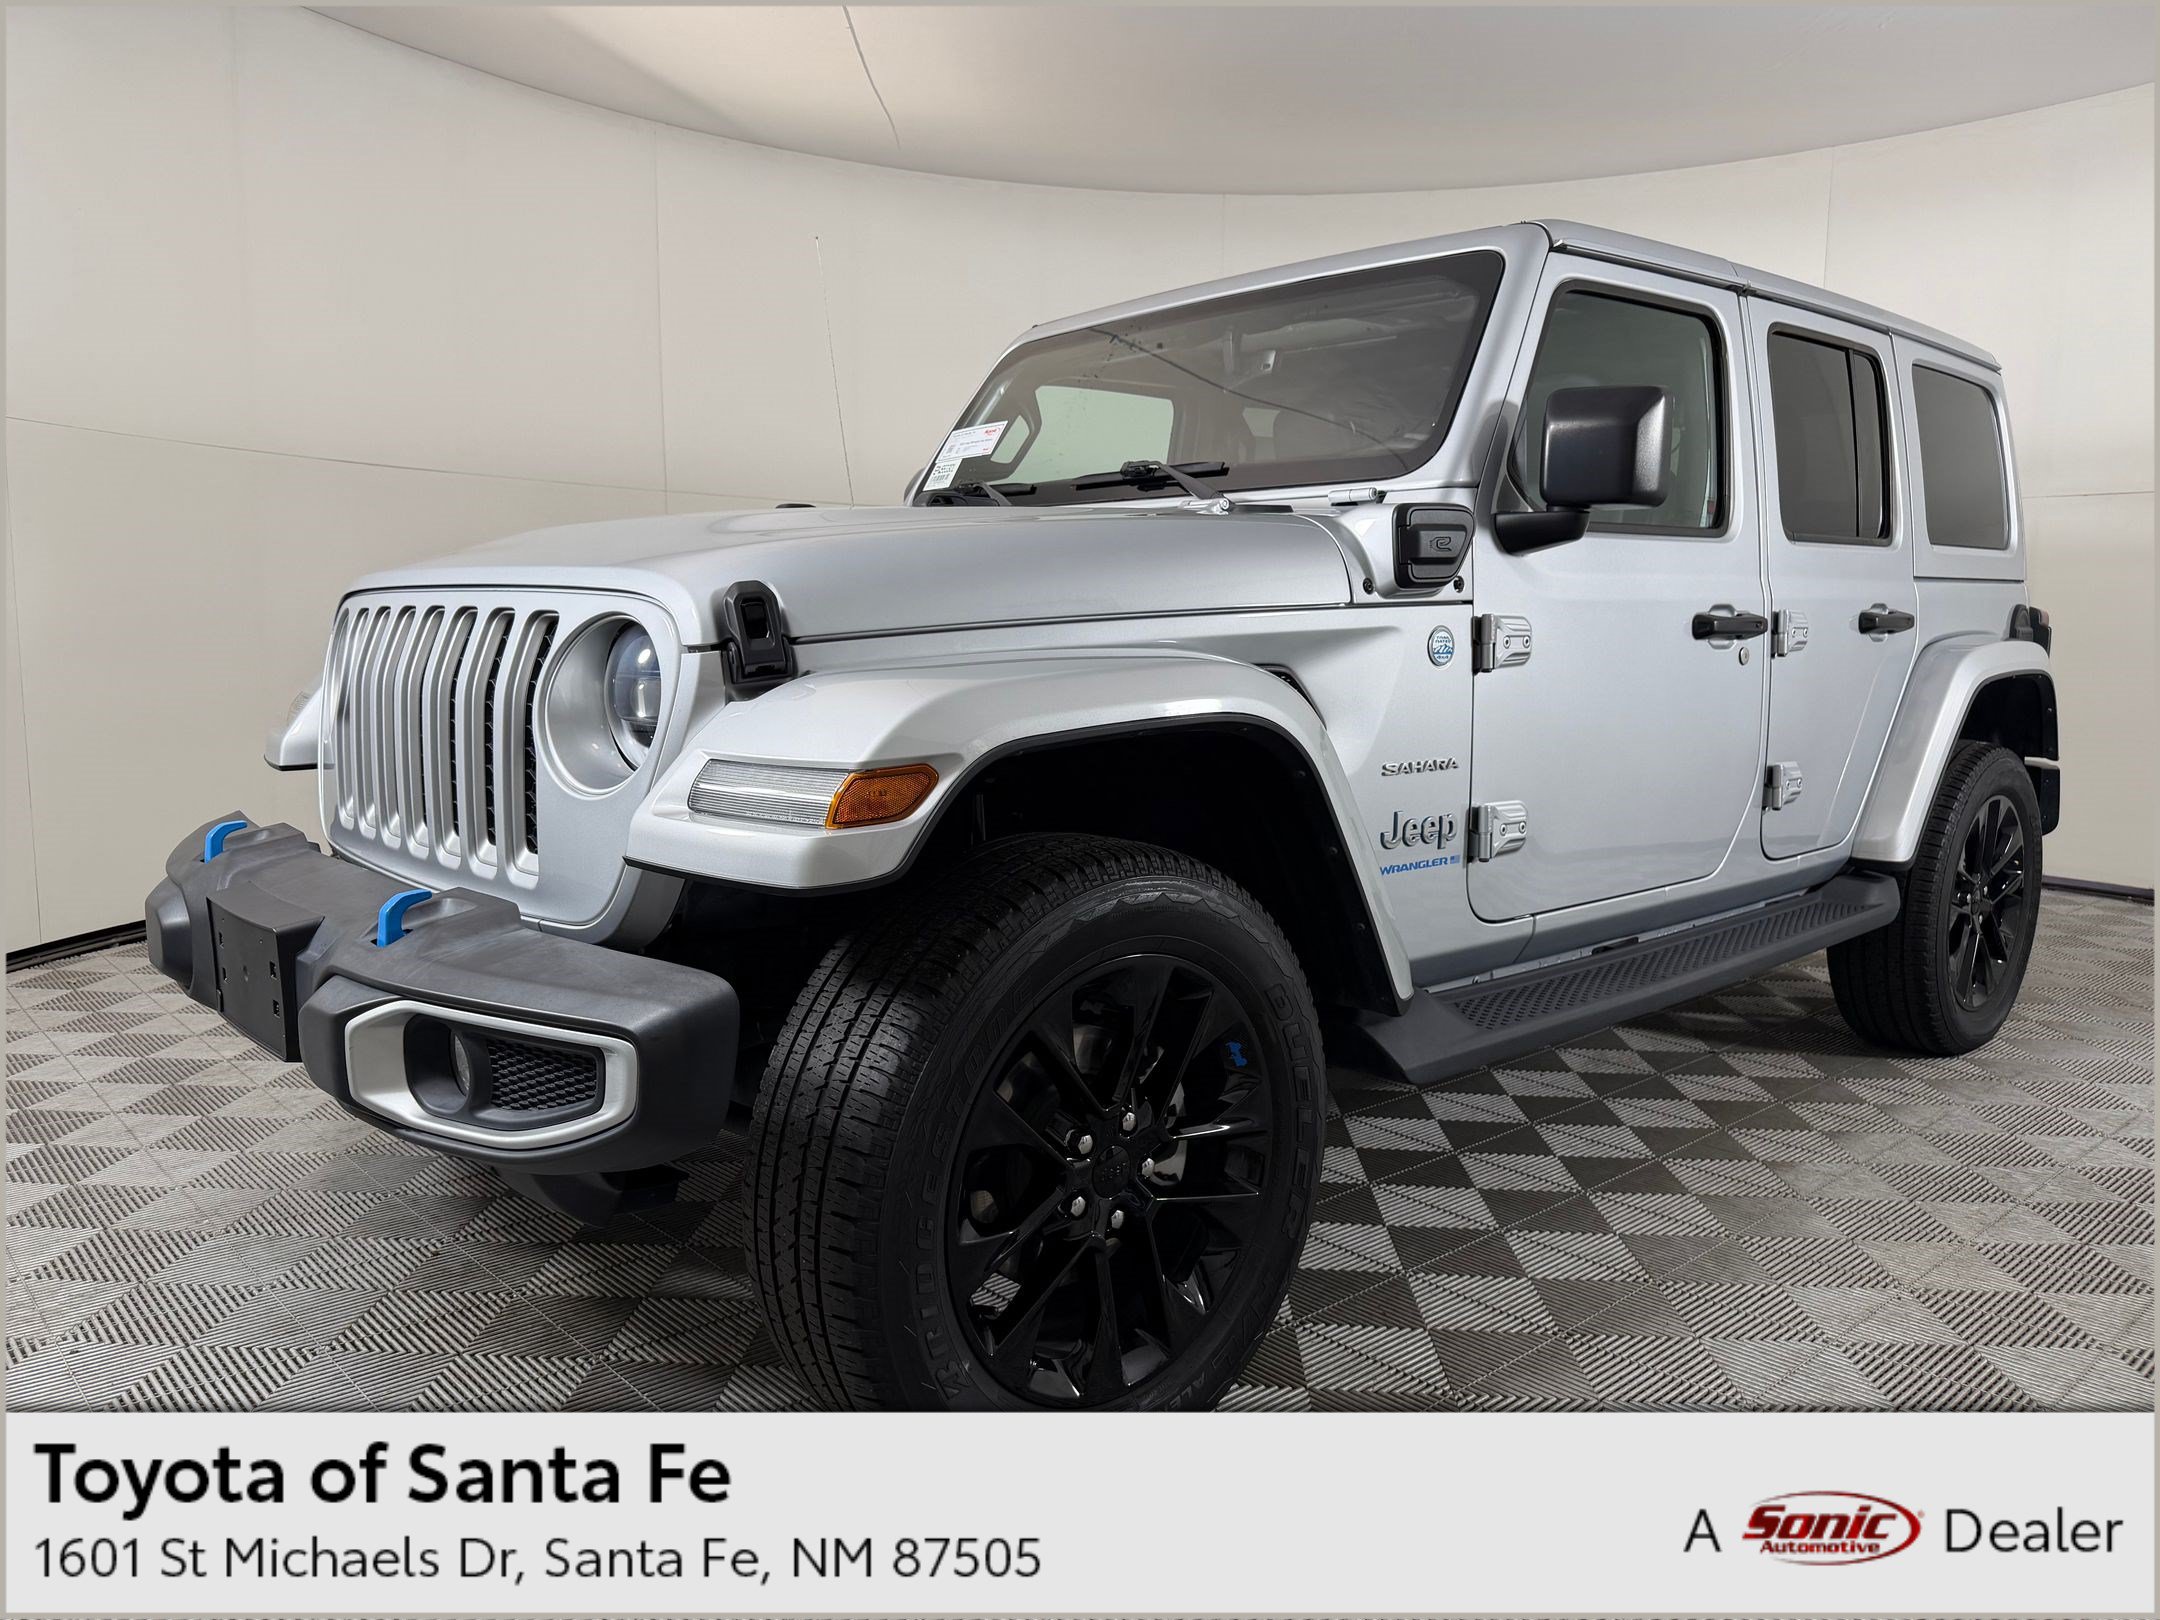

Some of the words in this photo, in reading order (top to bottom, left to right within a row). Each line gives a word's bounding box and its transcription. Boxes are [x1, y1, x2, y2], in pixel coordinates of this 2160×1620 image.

[1381, 757, 1458, 777] SAHARA
[1380, 810, 1458, 850] Jeep
[1380, 857, 1448, 876] WRANGLER
[1264, 983, 1312, 1240] DUELER
